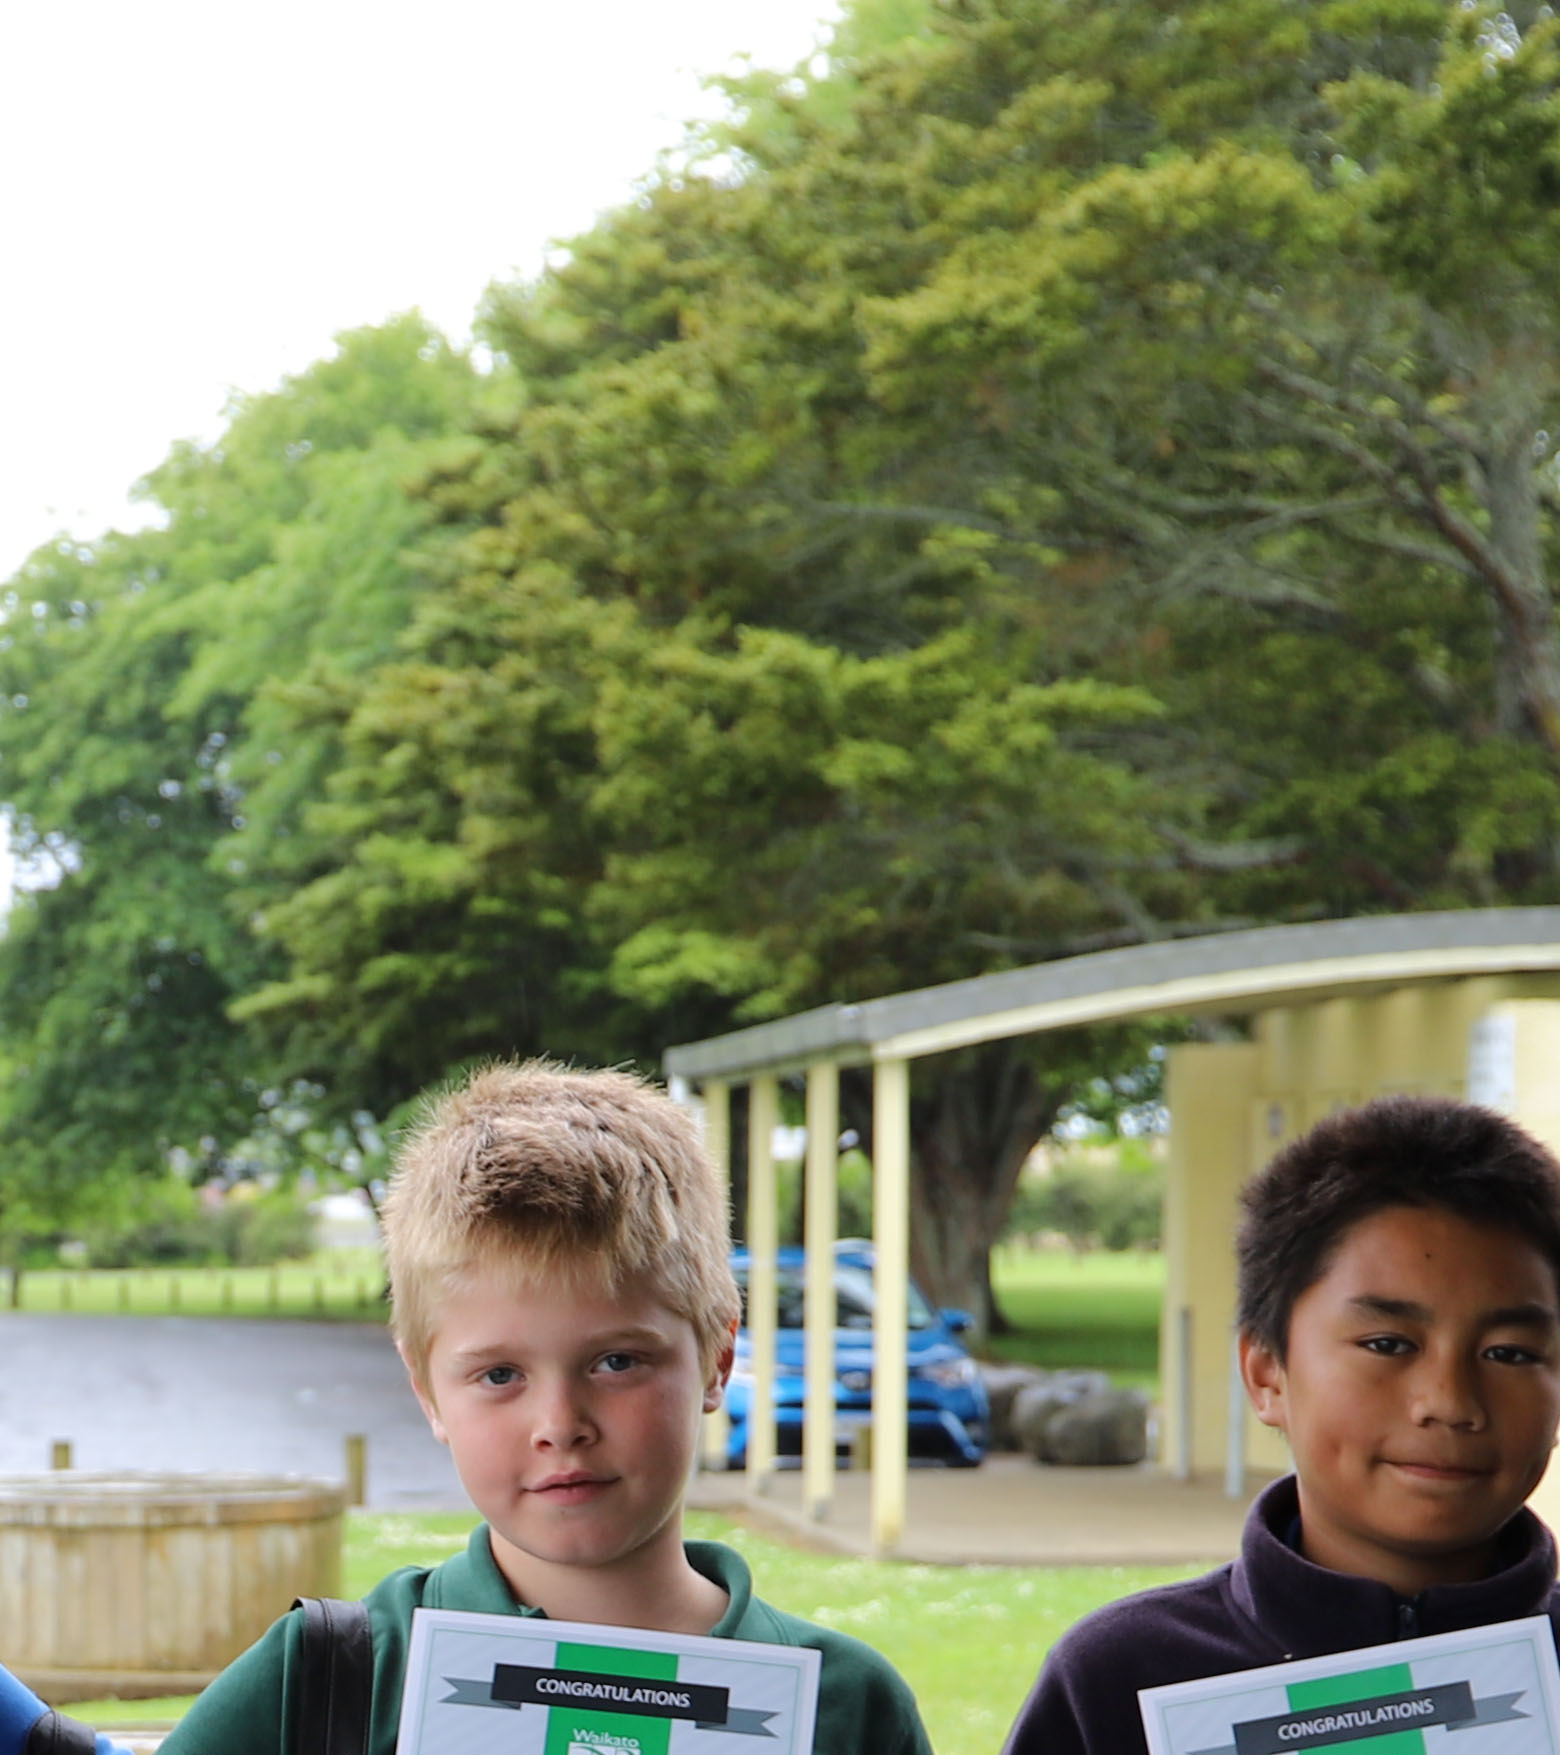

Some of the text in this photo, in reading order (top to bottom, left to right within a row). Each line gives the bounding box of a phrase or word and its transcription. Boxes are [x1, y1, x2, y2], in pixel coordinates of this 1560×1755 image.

[535, 1677, 690, 1707] CONGRATULATIONS
[1277, 1698, 1434, 1740] CONGRATULATIONS
[573, 1728, 639, 1748] Waikato
